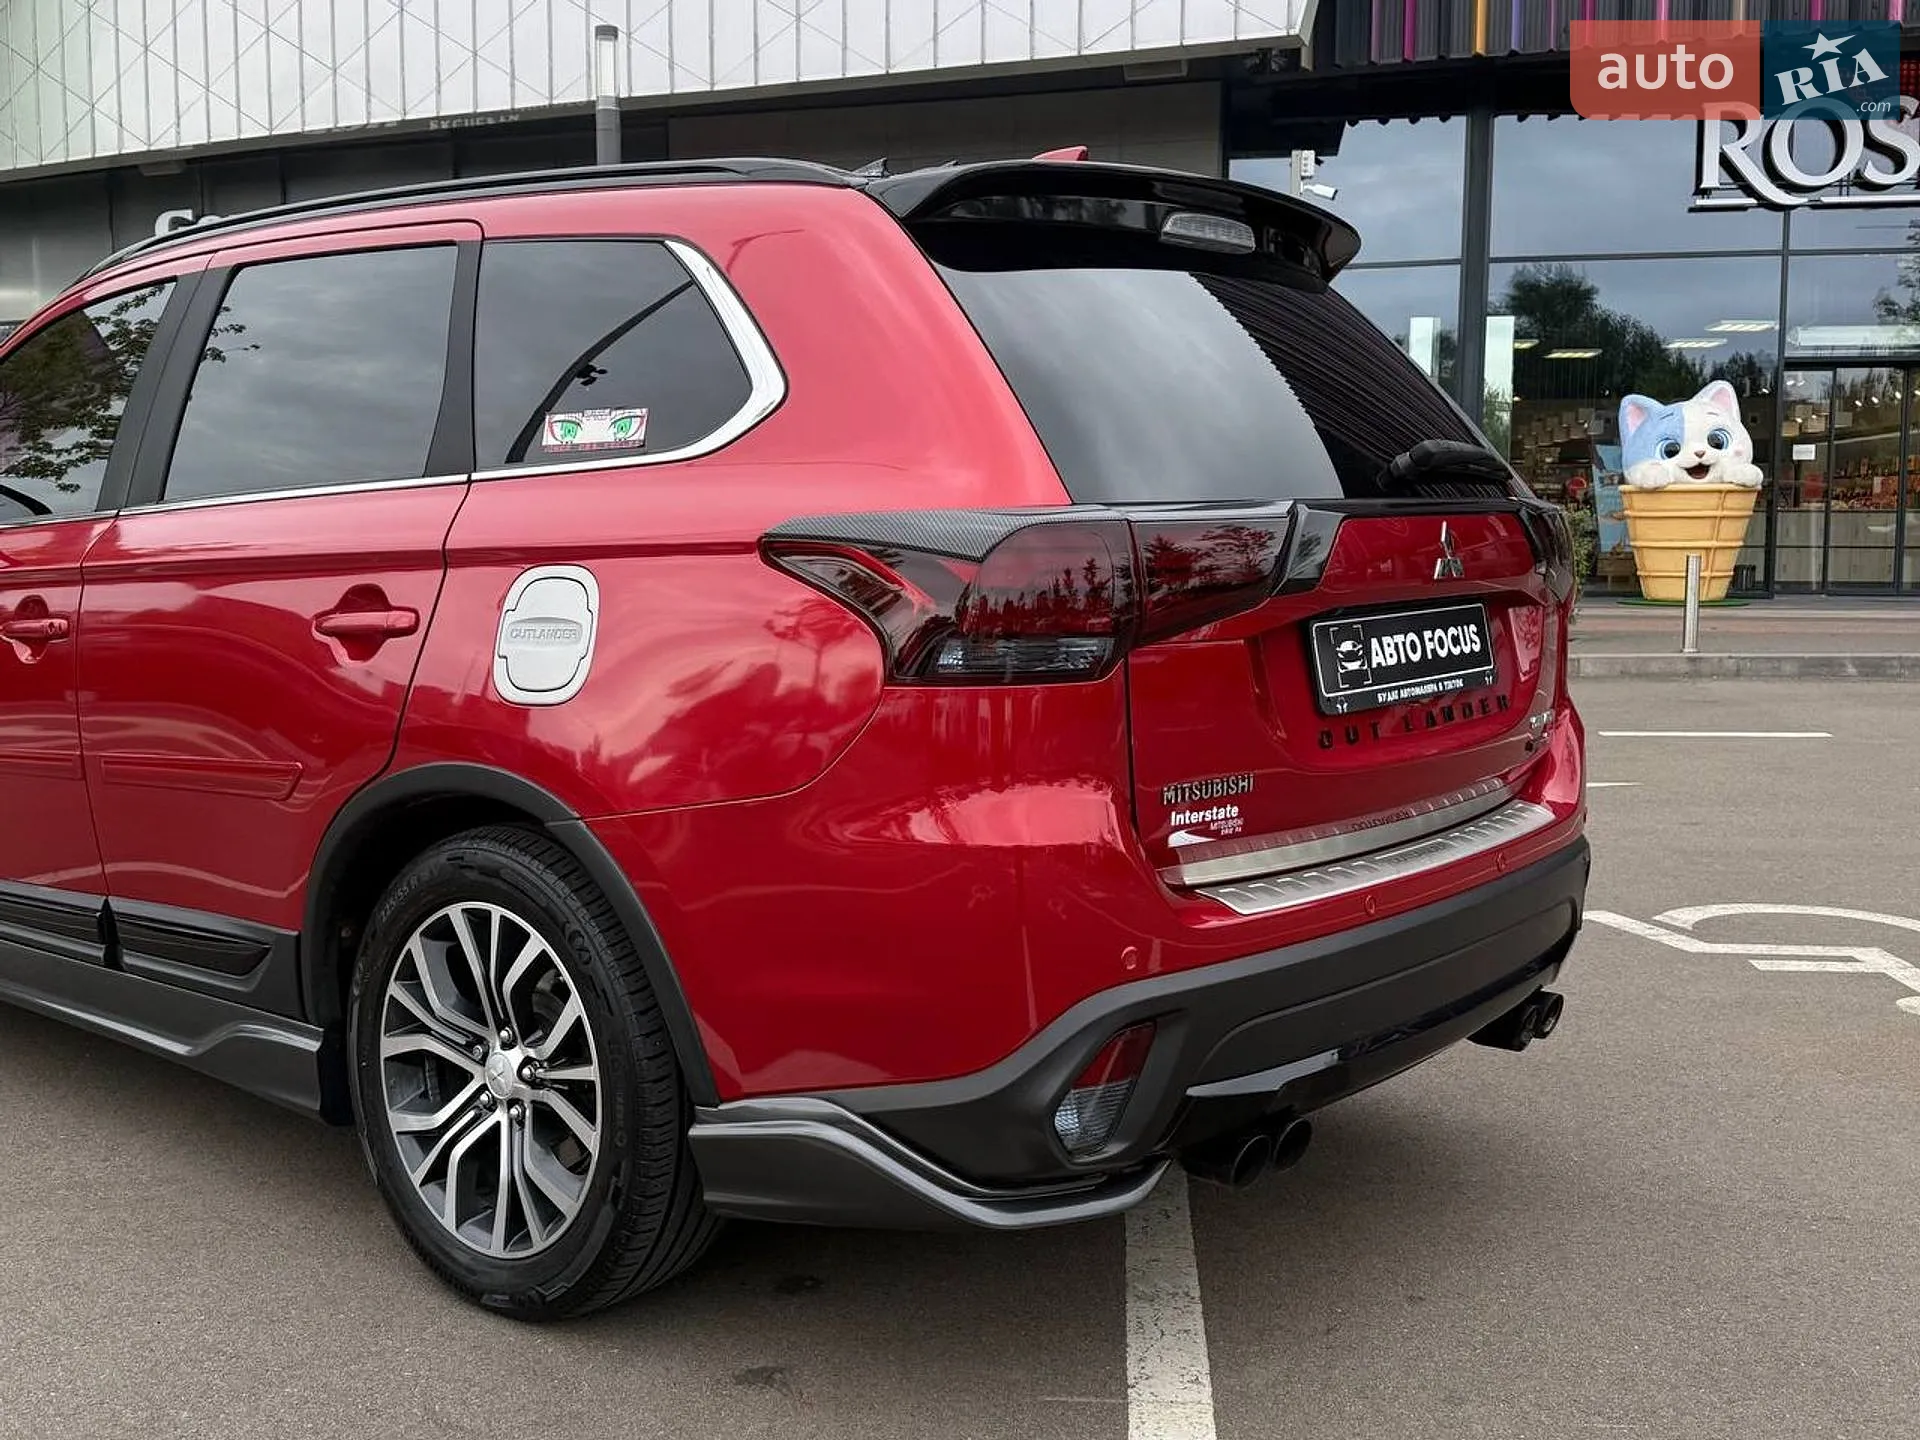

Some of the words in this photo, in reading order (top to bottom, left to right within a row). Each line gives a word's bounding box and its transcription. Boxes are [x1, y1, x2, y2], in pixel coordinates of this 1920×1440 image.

[511, 627, 577, 640] OUTLANDER
[1423, 624, 1480, 660] FOCUS
[1163, 774, 1254, 805] MITSUBISHI
[1170, 804, 1239, 826] Interstate
